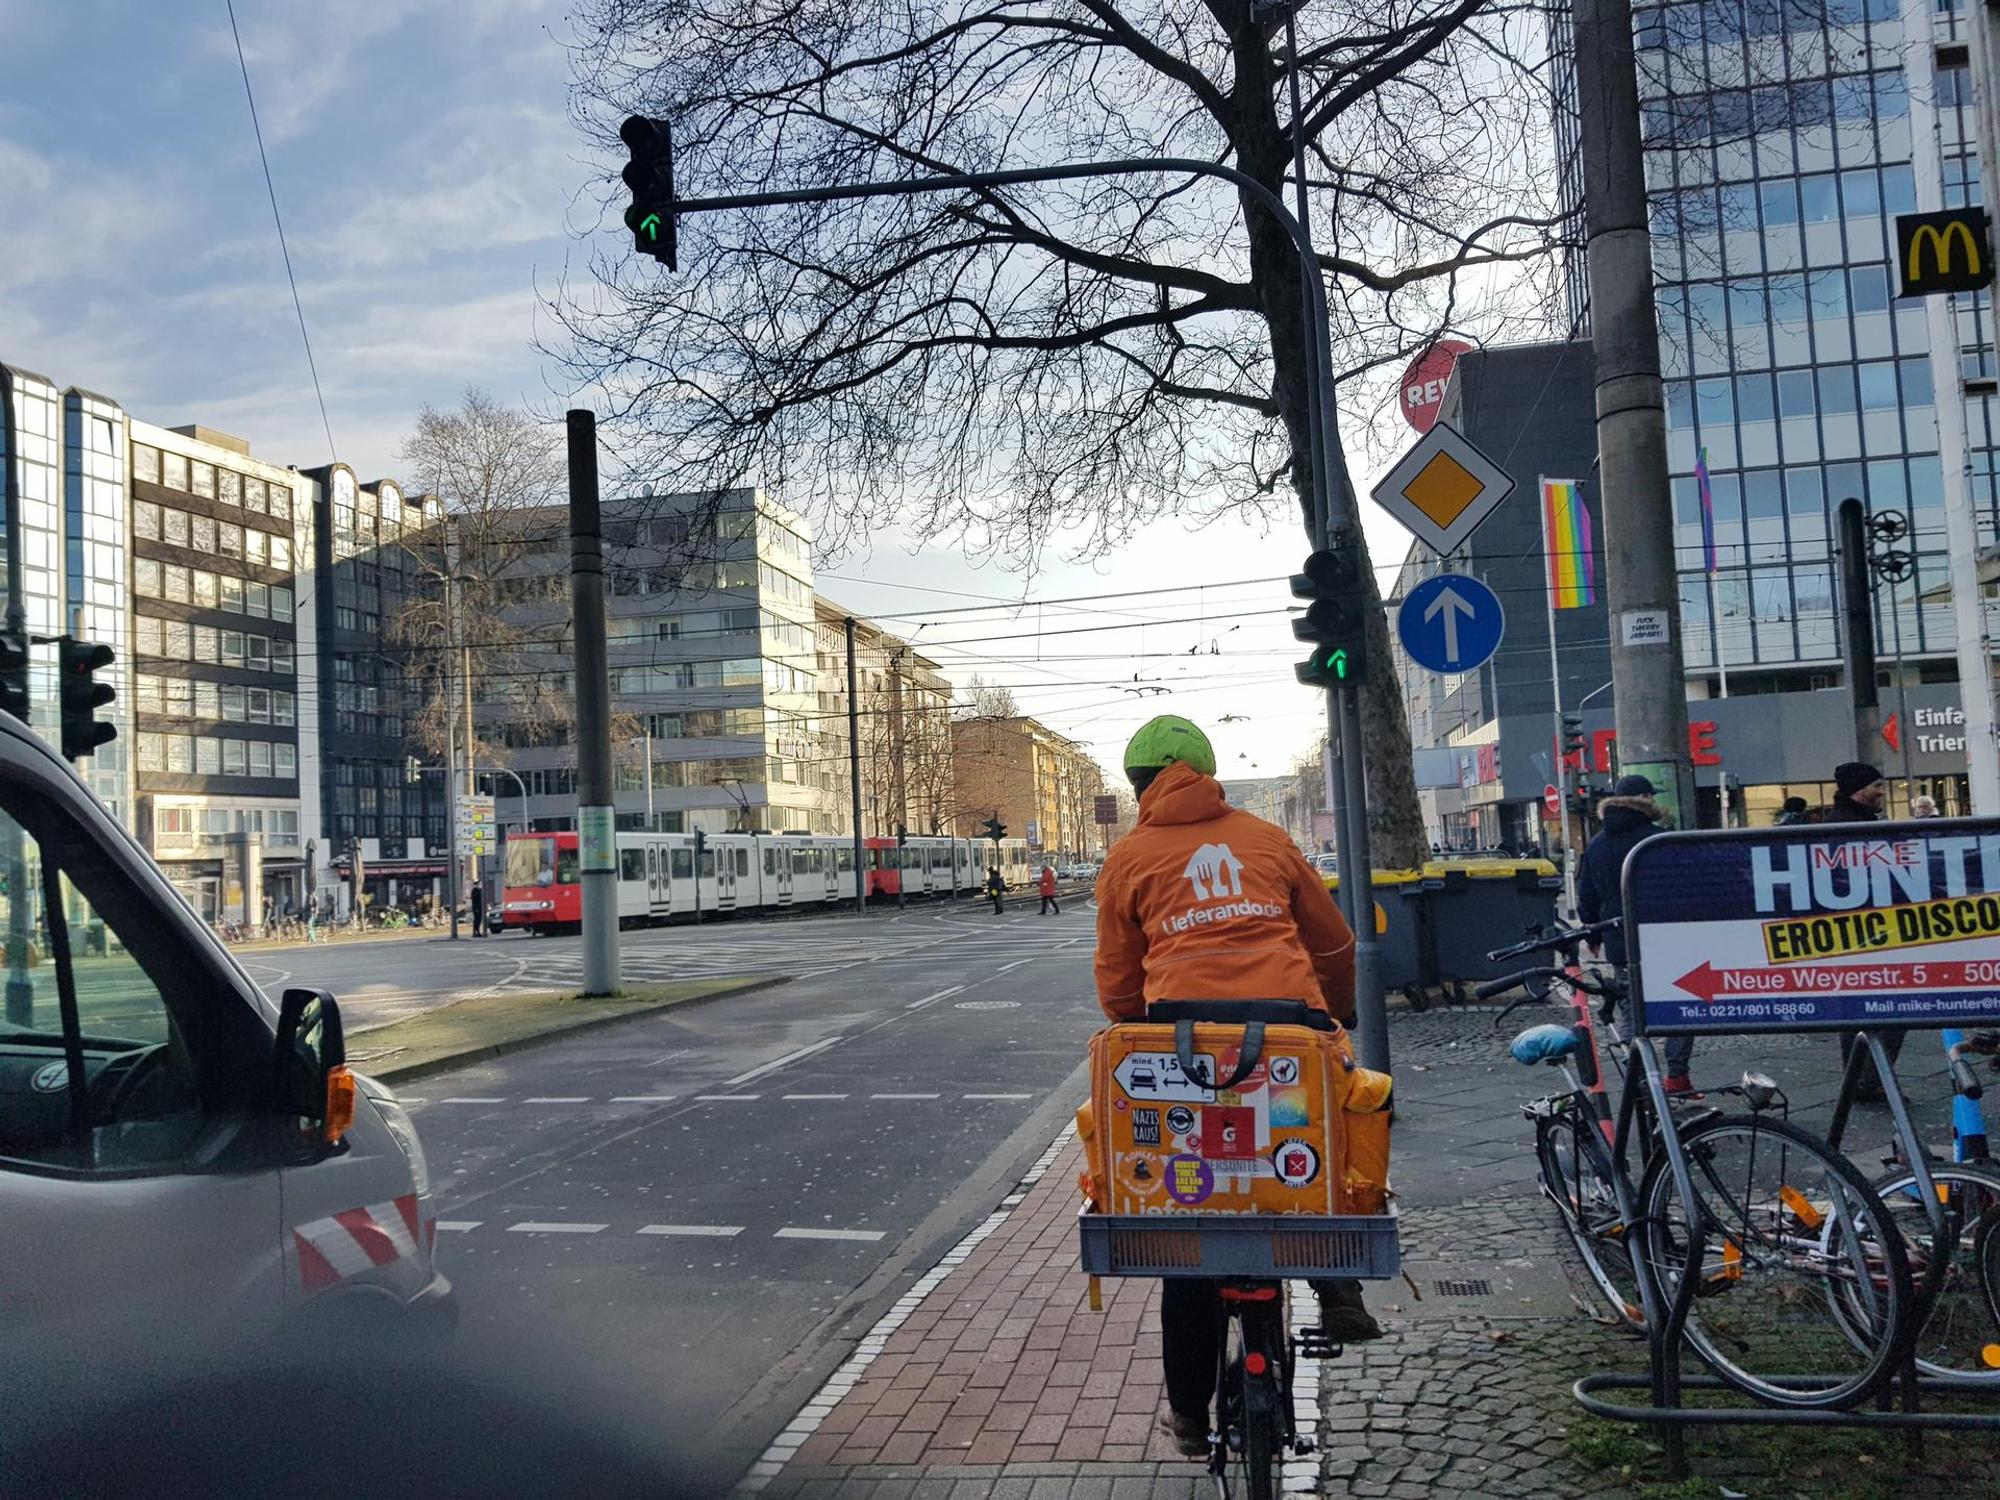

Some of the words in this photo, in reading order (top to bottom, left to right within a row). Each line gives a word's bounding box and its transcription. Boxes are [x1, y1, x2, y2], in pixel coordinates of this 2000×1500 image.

[1407, 378, 1449, 409] RE
[1914, 706, 1966, 727] Einfa
[1917, 734, 1967, 752] Trier
[1815, 842, 1921, 868] MIKE
[1161, 899, 1283, 936] Lieferando.de
[1768, 911, 1889, 960] EROTIC
[1895, 897, 2000, 943] DISCO
[1723, 969, 1786, 991] Neue
[1792, 967, 1905, 992] Weyerstr.
[1912, 964, 1927, 984] 5
[1680, 1005, 1707, 1017] Tel.:
[1865, 1000, 1894, 1012] Mail
[1131, 1057, 1155, 1065] mind.
[1133, 1109, 1160, 1125] NAZIS
[1133, 1125, 1159, 1142] RAUS!
